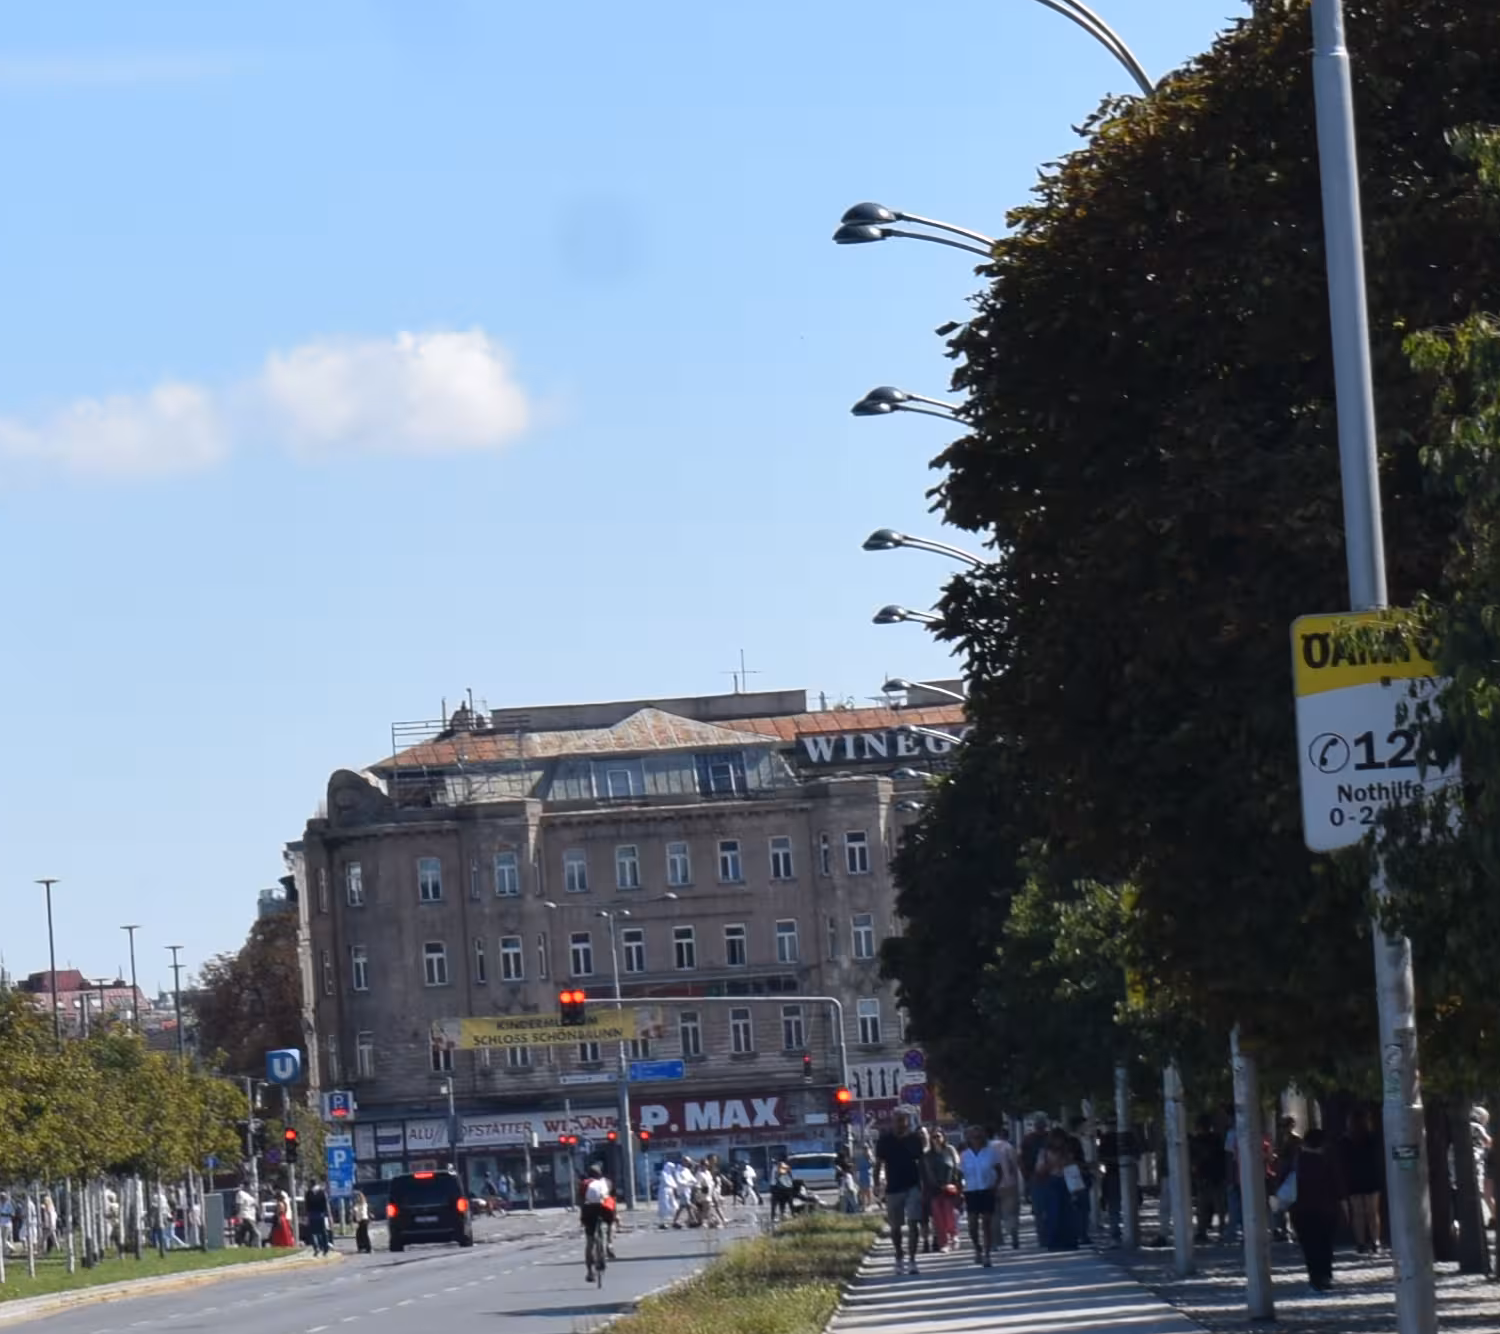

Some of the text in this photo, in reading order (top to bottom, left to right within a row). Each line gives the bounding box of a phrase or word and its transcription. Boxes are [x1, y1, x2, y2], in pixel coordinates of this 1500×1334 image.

[1354, 729, 1449, 771] 12
[1337, 780, 1425, 803] Nothilfe
[497, 1016, 598, 1031] KINDERMUM
[473, 1033, 528, 1046] SCHLOSS
[272, 1058, 293, 1079] U
[333, 1095, 345, 1109] P
[334, 1150, 346, 1168] P
